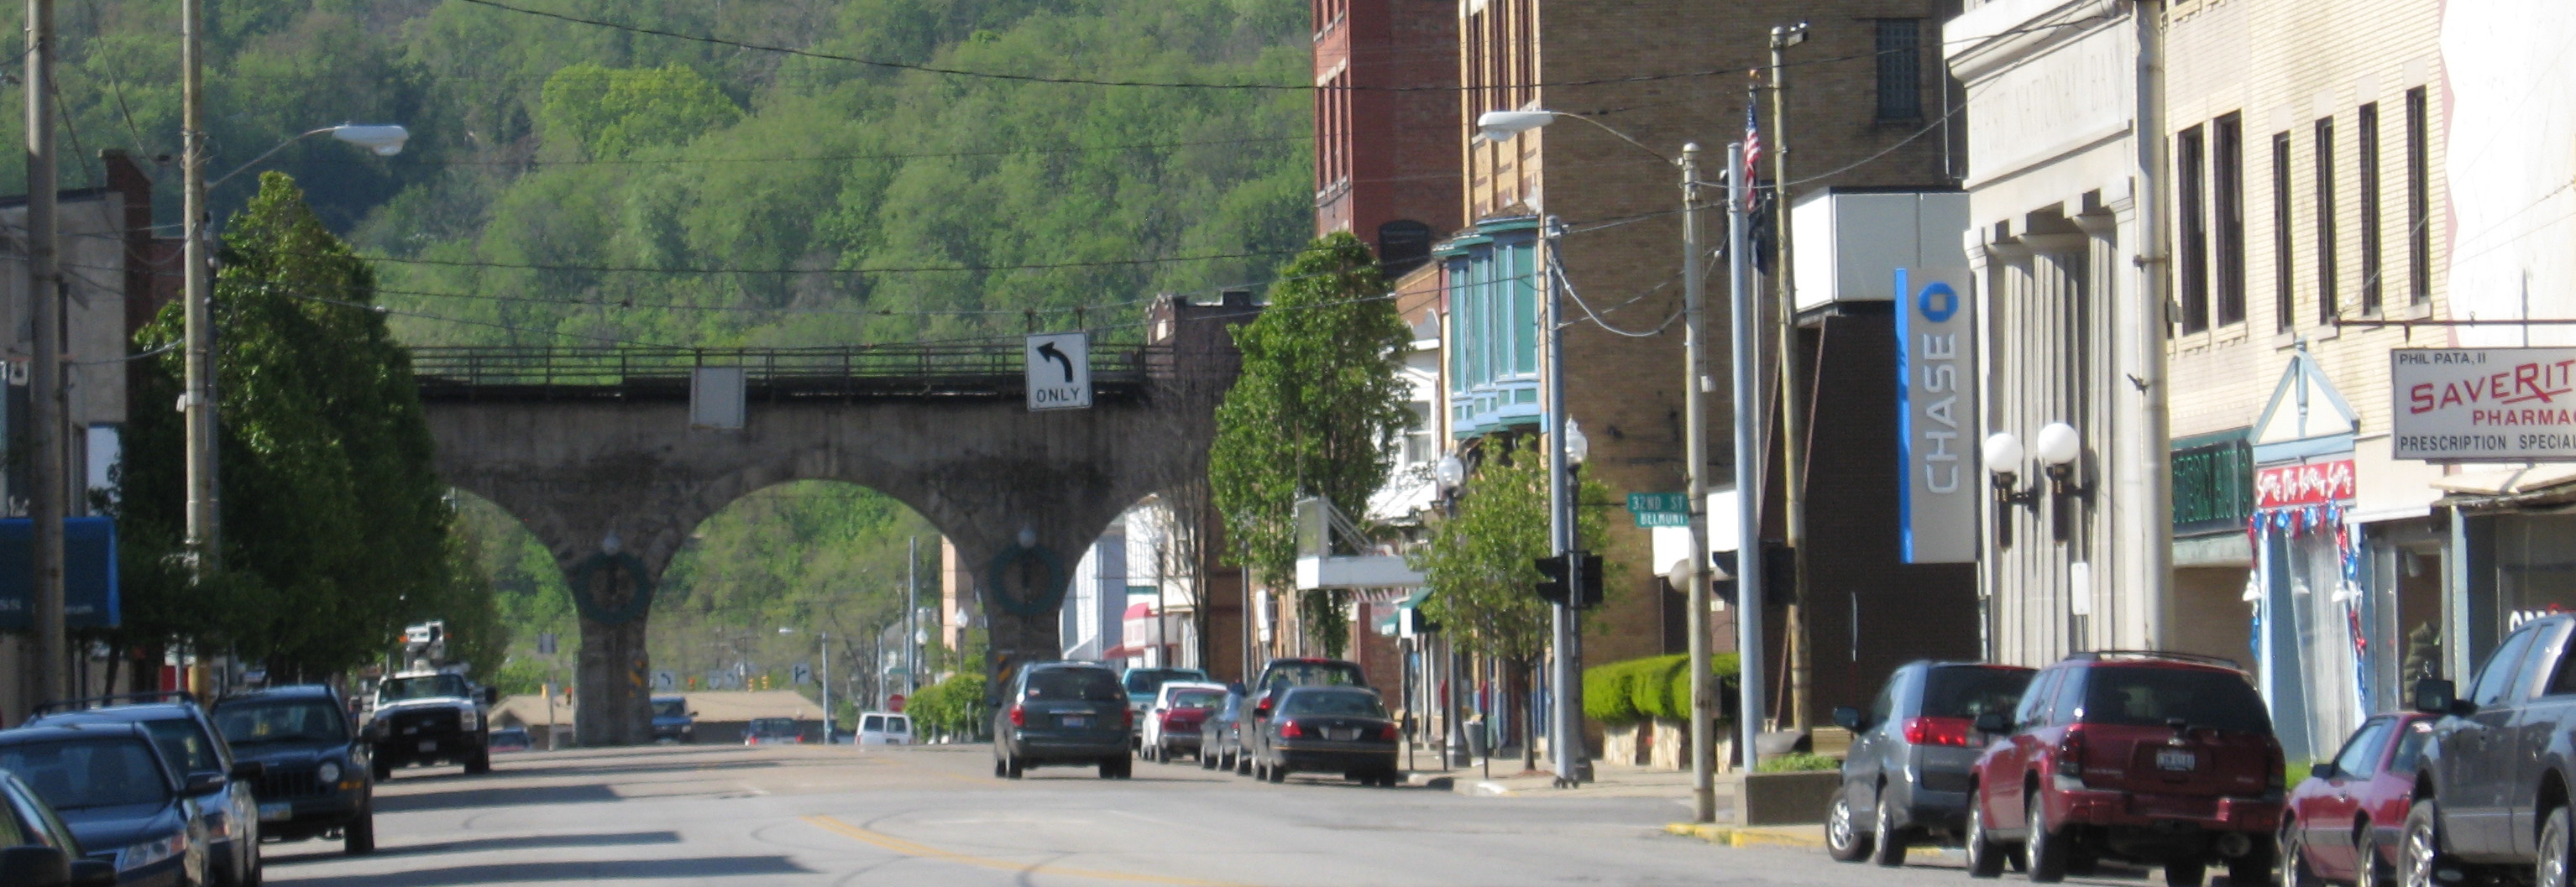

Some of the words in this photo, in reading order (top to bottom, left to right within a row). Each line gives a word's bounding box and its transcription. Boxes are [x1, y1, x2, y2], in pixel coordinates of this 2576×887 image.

[2015, 61, 2081, 138] NATIONAL
[2400, 353, 2430, 364] PHIL
[2435, 352, 2475, 365] PATA,
[1036, 388, 1080, 403] ONLY
[1924, 334, 1960, 494] CHASE
[2473, 410, 2576, 425] PHARMA
[2401, 435, 2505, 451] PRESCRIPTION
[1632, 496, 1661, 510] 32ND
